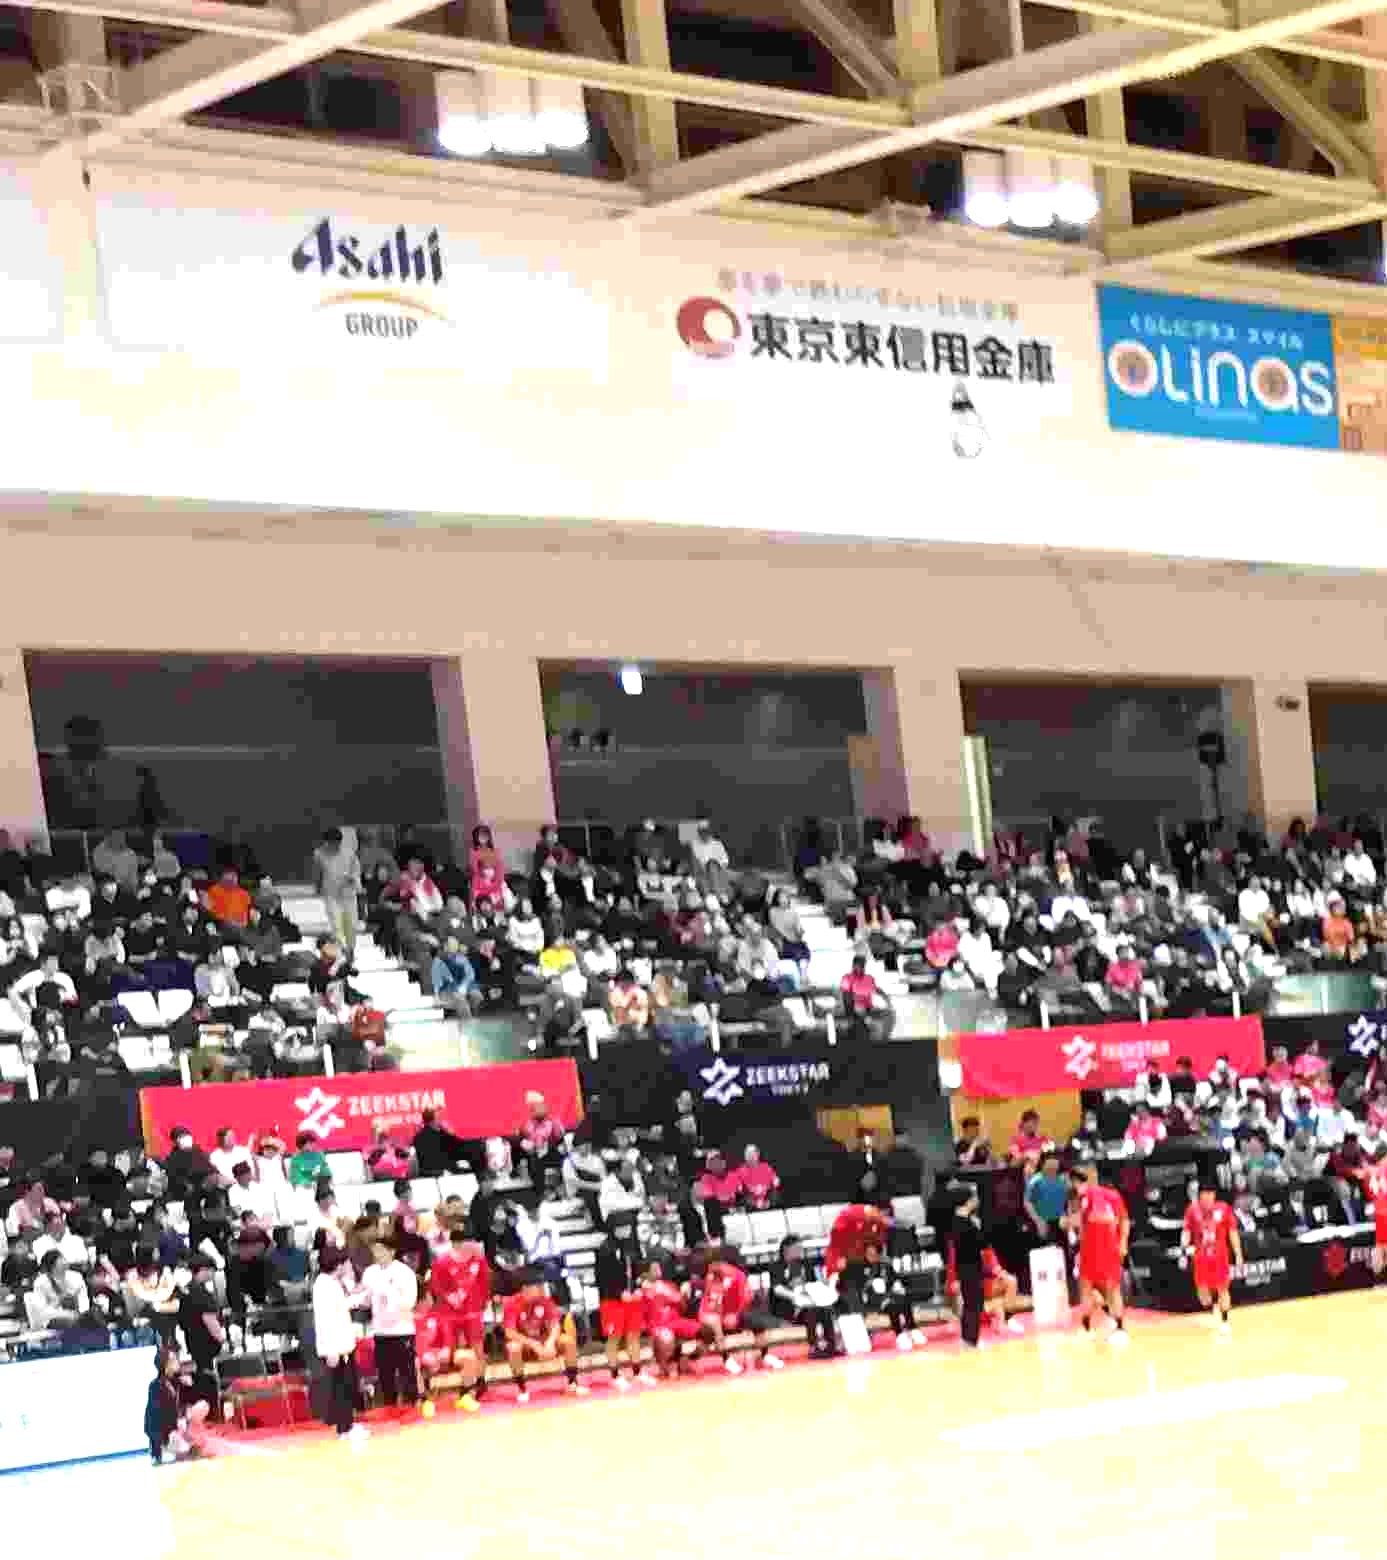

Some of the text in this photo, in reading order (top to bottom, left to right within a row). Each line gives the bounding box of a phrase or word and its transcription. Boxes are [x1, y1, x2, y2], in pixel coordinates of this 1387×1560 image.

[291, 216, 443, 286] Asahi
[344, 312, 419, 339] GROUP
[748, 312, 1054, 386] 東京東信用金庫
